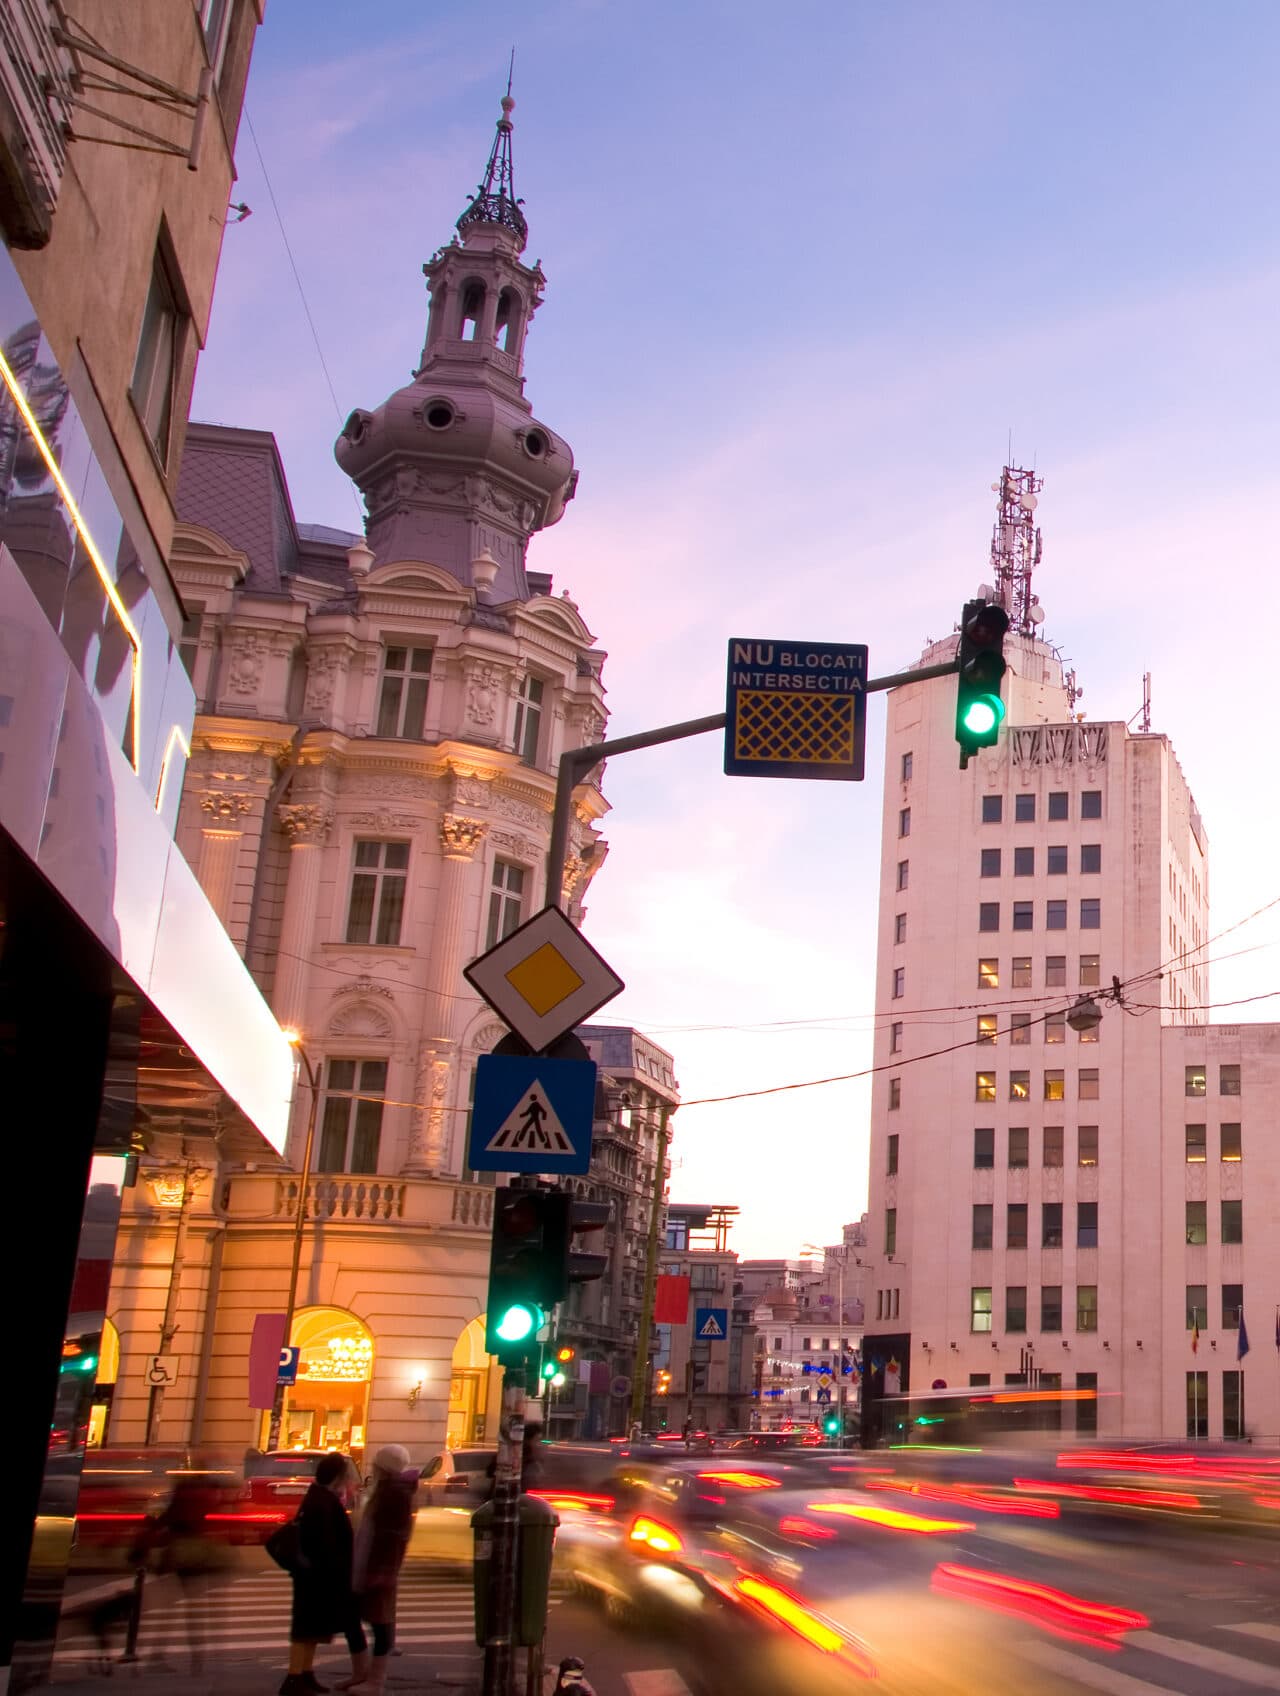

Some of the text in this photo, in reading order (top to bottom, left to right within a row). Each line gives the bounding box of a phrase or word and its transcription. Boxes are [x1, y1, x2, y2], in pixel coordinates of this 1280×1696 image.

[734, 643, 863, 669] NU BLOCATI
[732, 671, 862, 691] INTERSECTIA
